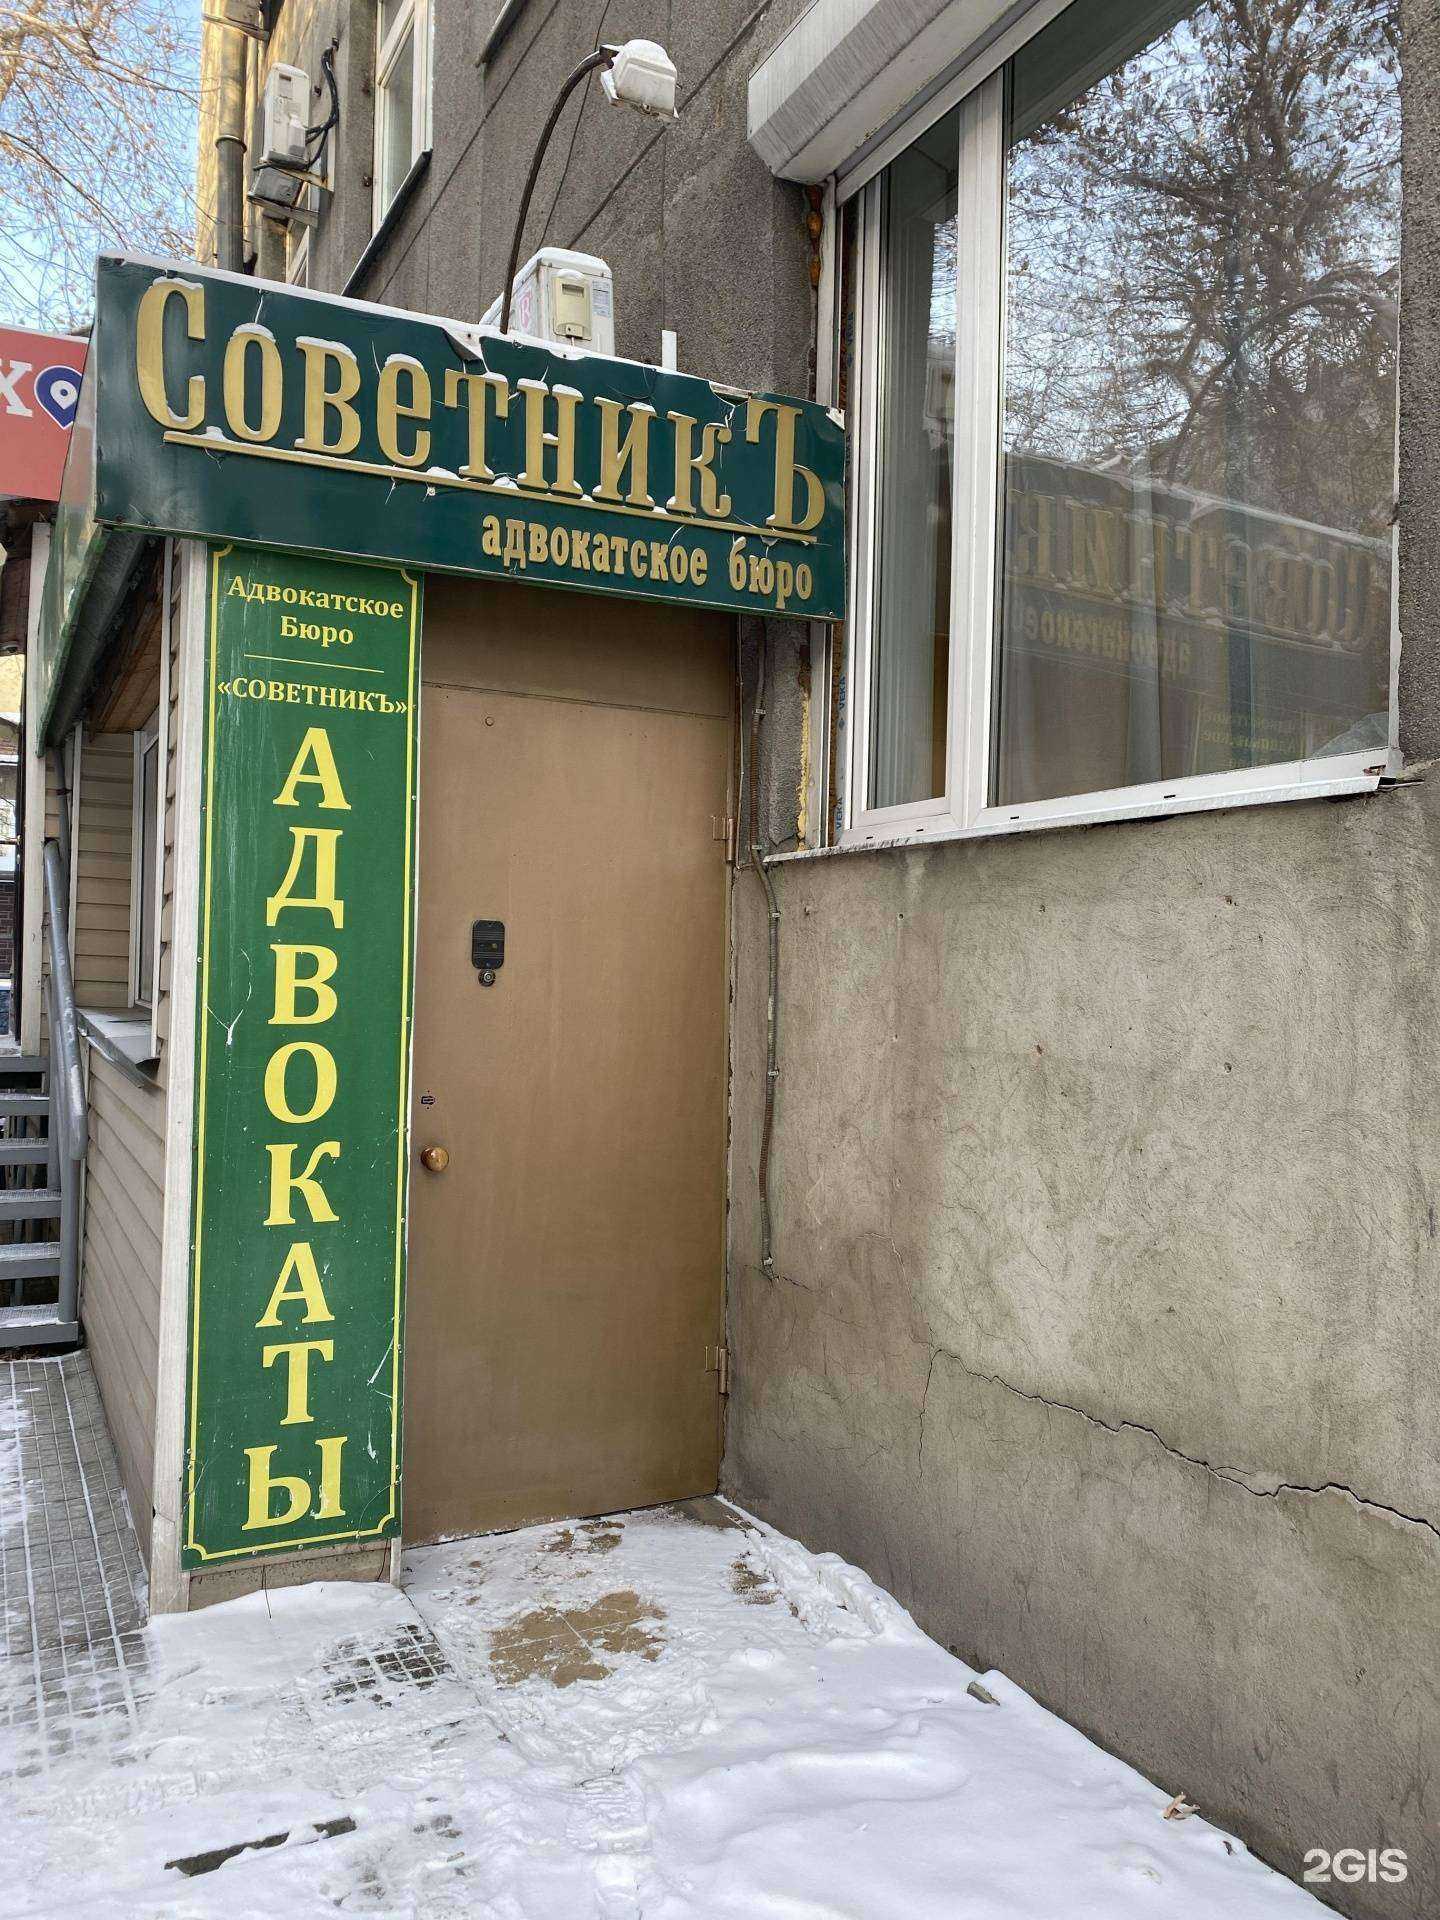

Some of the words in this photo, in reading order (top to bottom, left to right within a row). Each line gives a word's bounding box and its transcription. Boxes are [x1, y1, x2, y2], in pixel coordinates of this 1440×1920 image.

[482, 515, 708, 586] адвокатское
[729, 536, 813, 609] бюро
[227, 575, 404, 618] Адвокатское
[280, 615, 354, 647] Бюро
[217, 676, 408, 714] «СОВЕТНИКЪ»
[839, 675, 847, 710] VEKA
[242, 727, 352, 1532] АДВОКАТЫ
